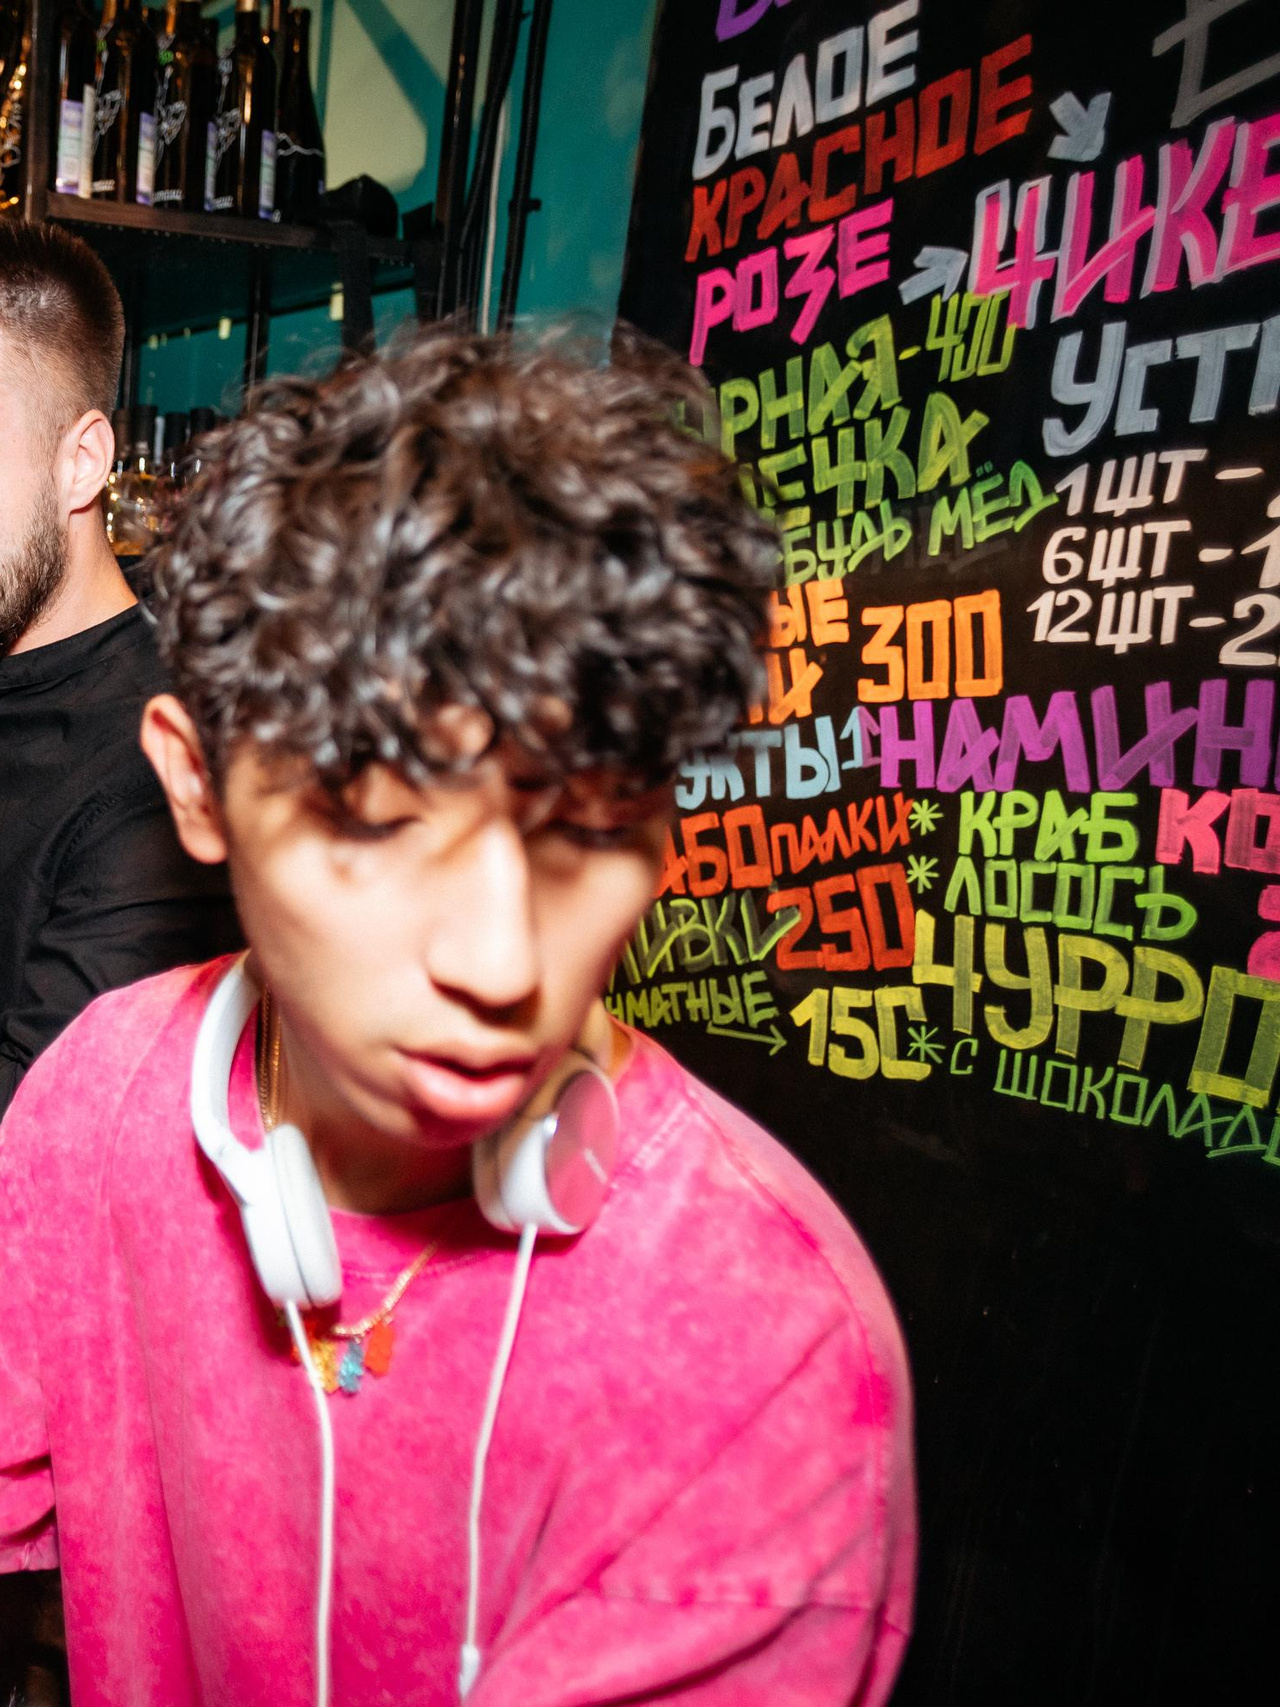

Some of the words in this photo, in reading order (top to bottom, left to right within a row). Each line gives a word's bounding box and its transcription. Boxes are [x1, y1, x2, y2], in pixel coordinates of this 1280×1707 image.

[684, 34, 1033, 262] КРАСНОЕ
[692, 0, 919, 181] БЕЛОЕ
[689, 198, 894, 367] РОЗЕ
[775, 499, 912, 588] БУДЬ
[927, 460, 1060, 557] МЁД
[858, 588, 1003, 703] 300
[958, 788, 1139, 863] КРАБ
[767, 863, 915, 972] 250
[944, 856, 1198, 941] ЛОСОСЬ
